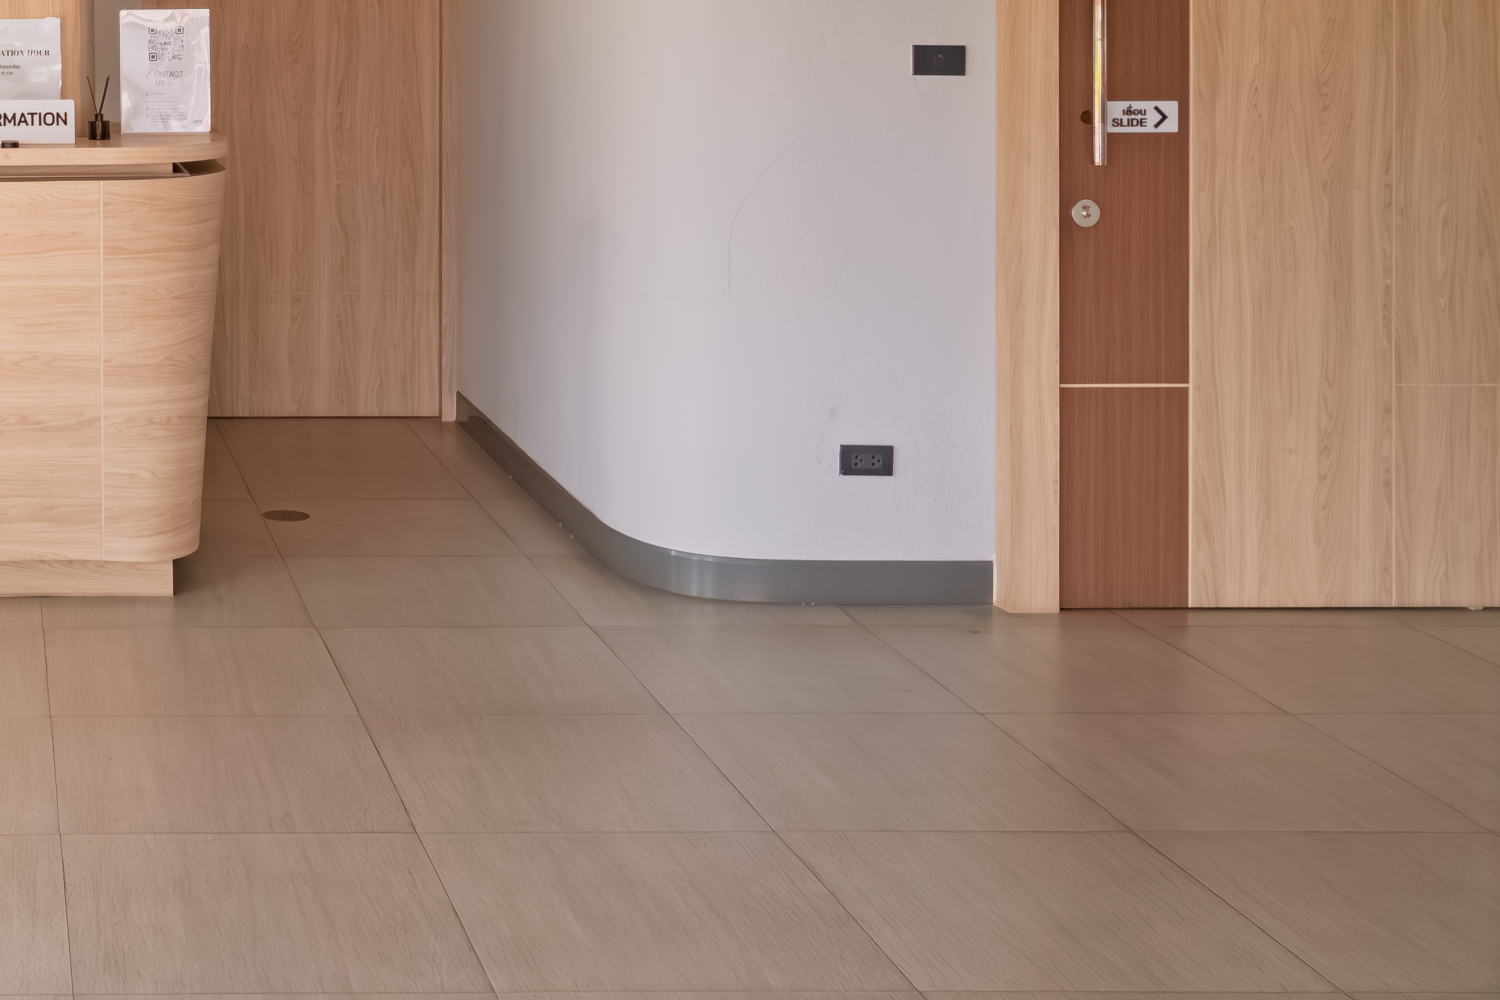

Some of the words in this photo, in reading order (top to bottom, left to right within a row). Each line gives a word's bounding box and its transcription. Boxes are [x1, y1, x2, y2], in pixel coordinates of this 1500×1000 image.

[27, 49, 50, 57] HOUR
[144, 69, 184, 78] CONTACT
[1122, 104, 1147, 116] เลื่อน
[1112, 118, 1147, 127] SLIDE
